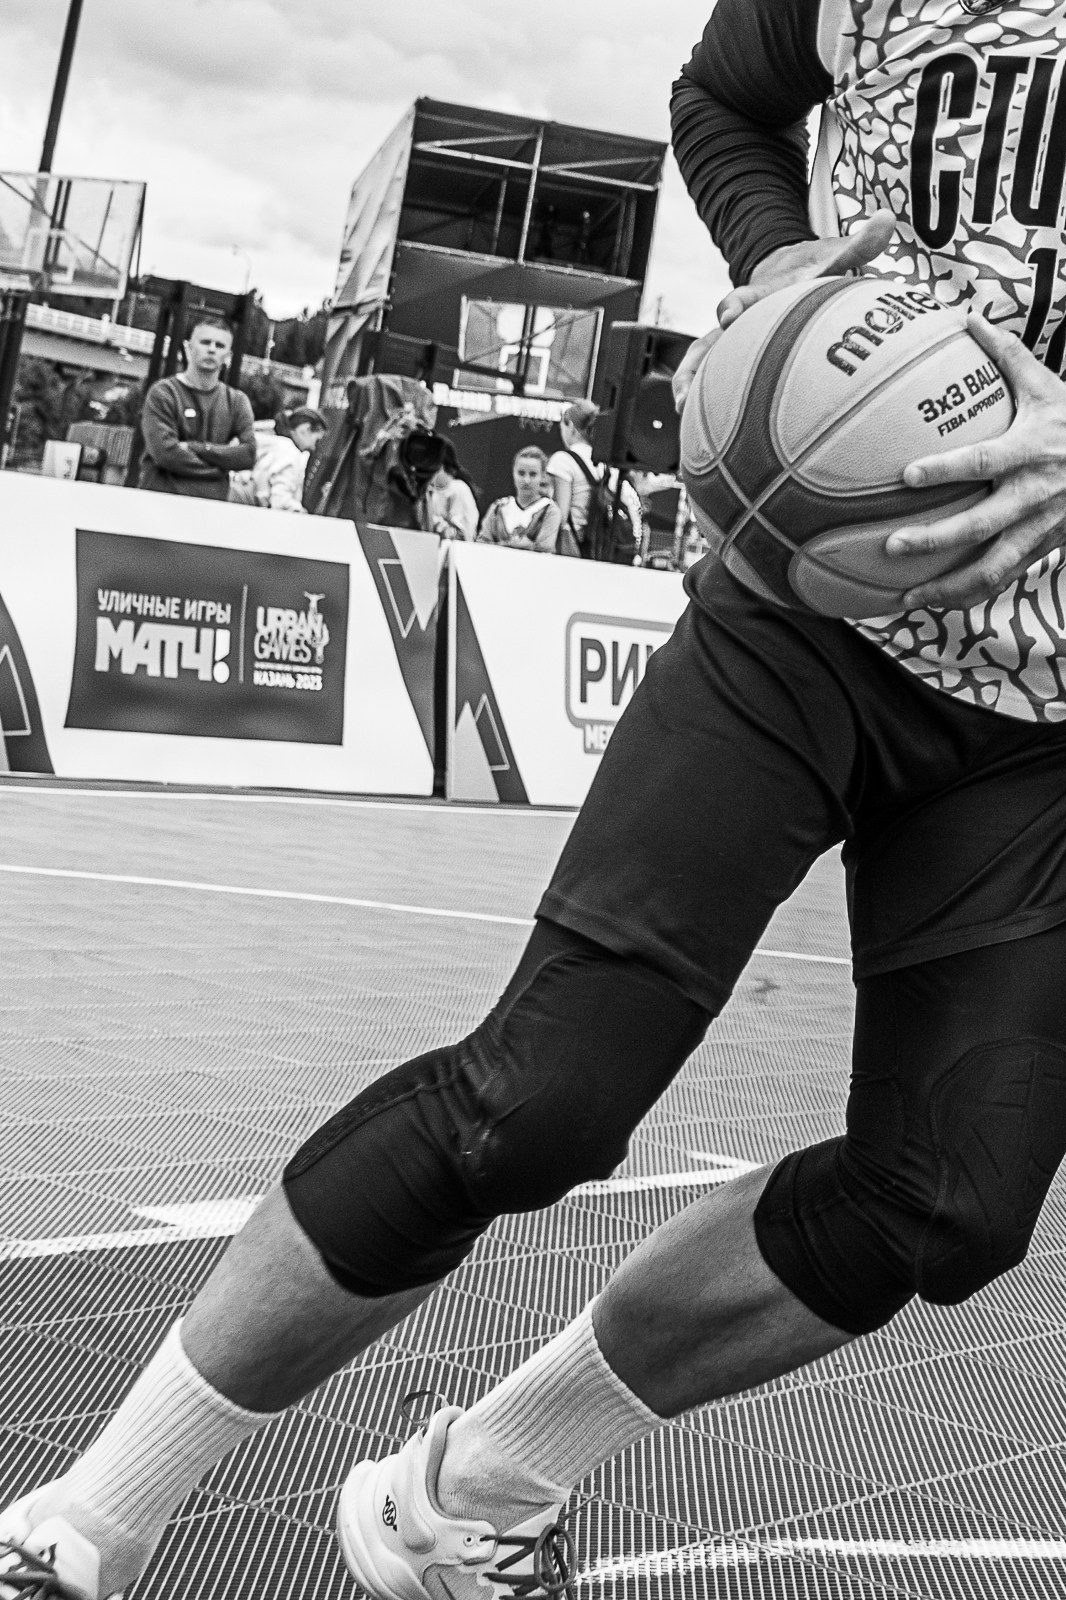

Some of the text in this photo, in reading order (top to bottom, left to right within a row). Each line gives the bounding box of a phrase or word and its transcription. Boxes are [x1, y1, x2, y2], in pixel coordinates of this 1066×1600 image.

[917, 360, 1001, 423] 3x3 BALL
[937, 413, 967, 437] FIBA
[97, 588, 232, 625] УЛИЧНЫЕ ИГРЫ
[256, 606, 323, 646] URBAN
[94, 616, 231, 684] МАТЧ!
[254, 632, 312, 663] GAMES
[580, 637, 654, 706] РИ
